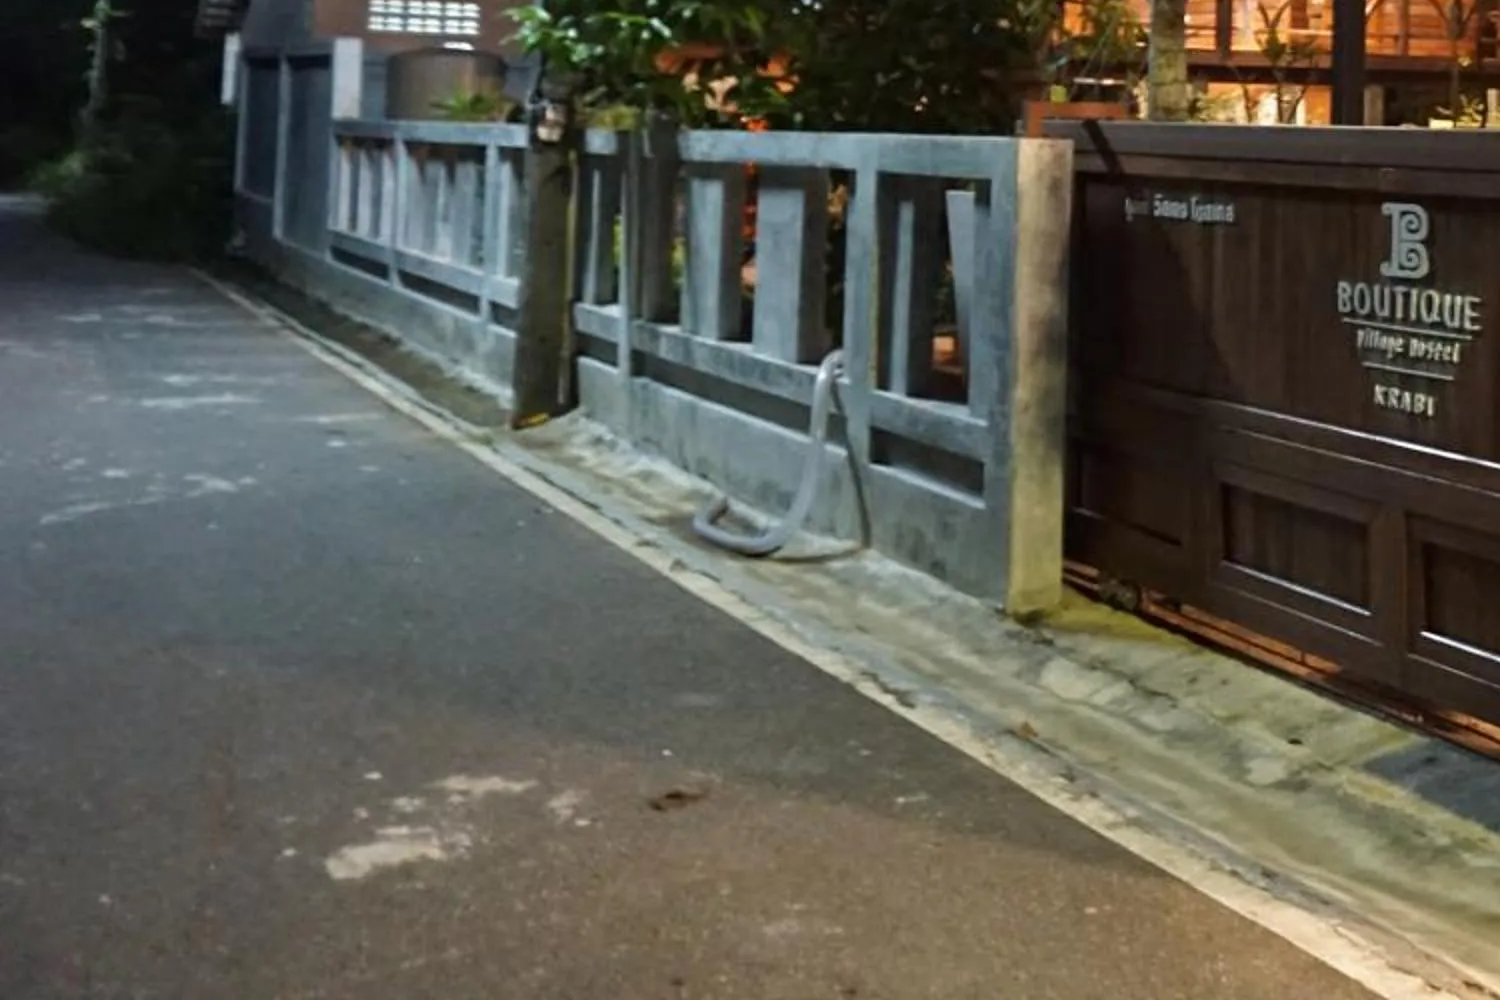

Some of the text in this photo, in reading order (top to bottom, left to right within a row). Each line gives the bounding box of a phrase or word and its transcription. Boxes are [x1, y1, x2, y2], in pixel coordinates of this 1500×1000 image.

[1380, 202, 1430, 279] B
[1336, 280, 1483, 331] BOUTIQUE
[1373, 384, 1435, 417] KRABI
